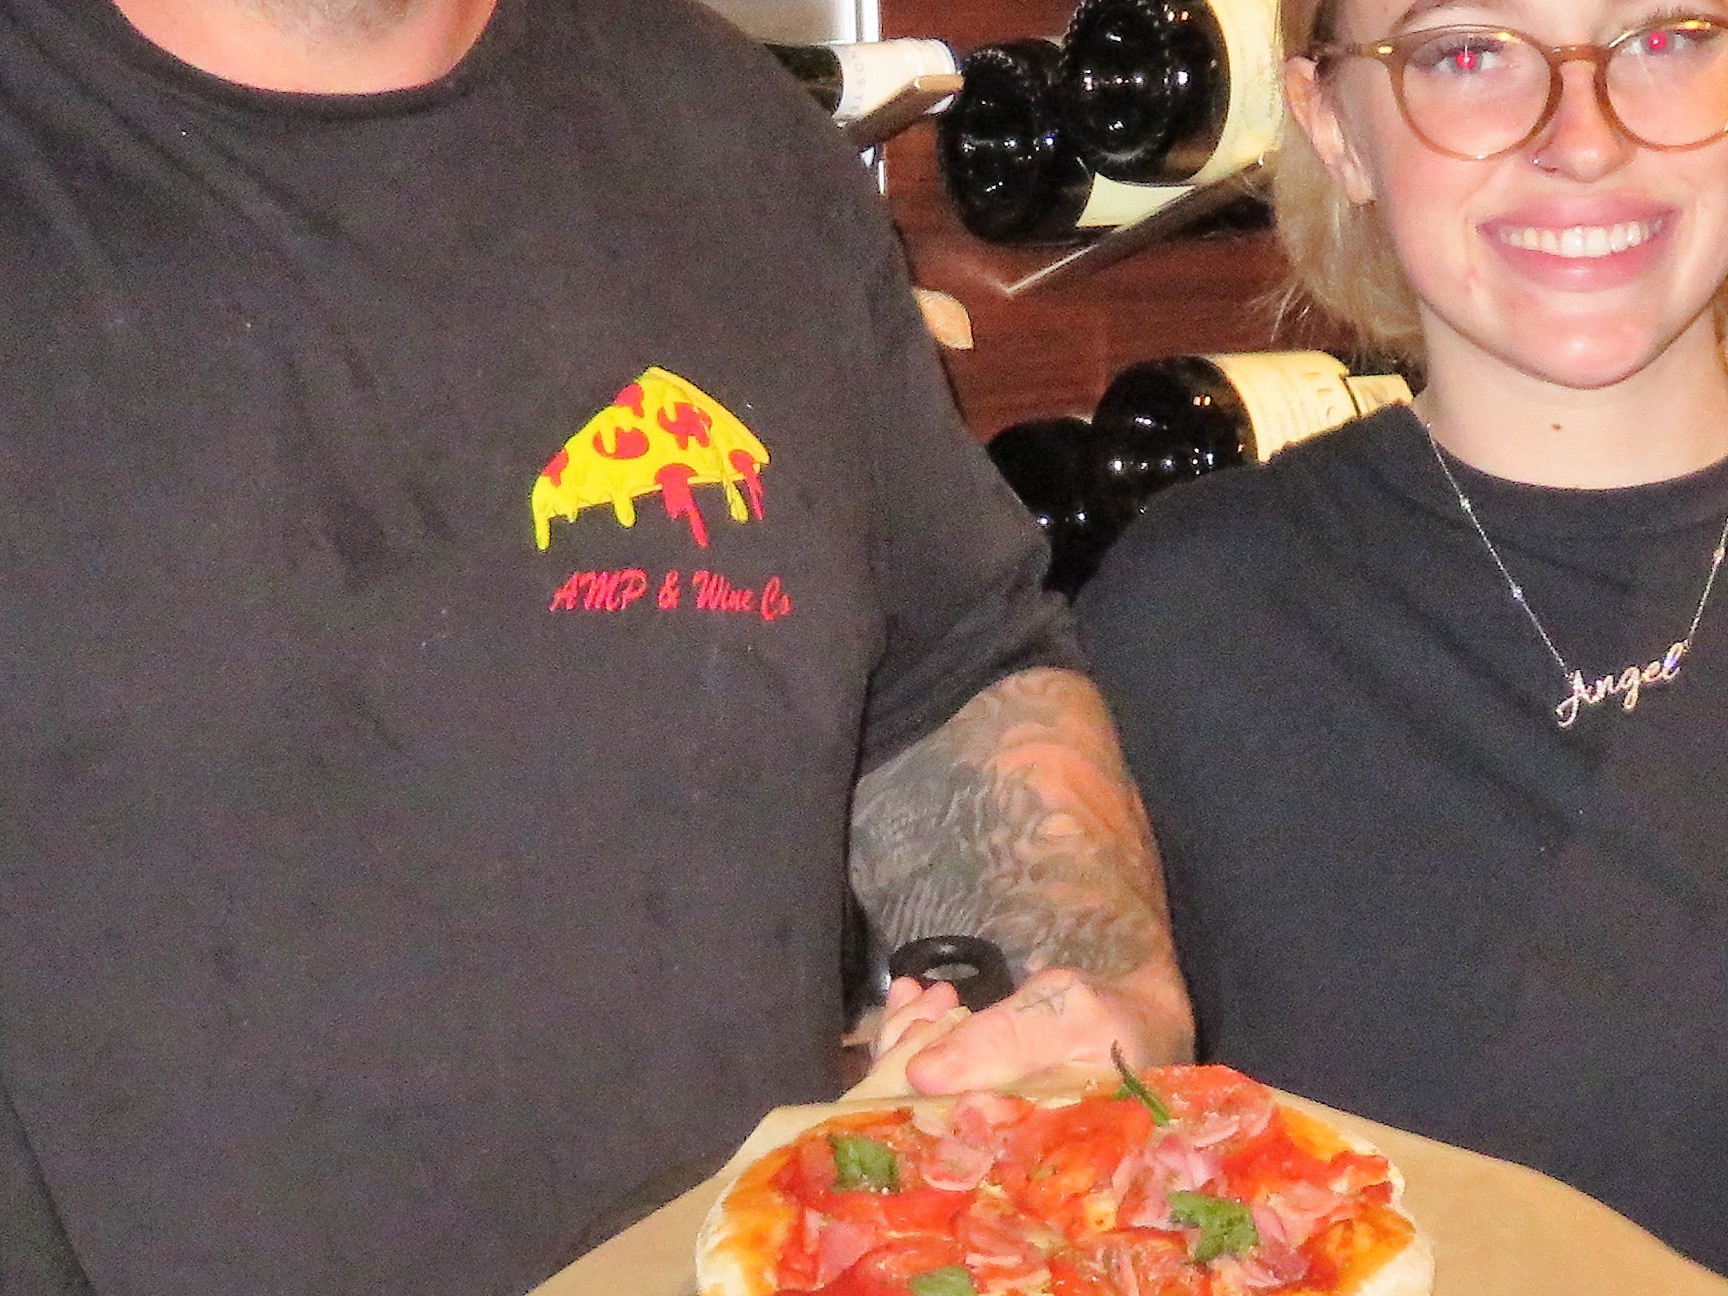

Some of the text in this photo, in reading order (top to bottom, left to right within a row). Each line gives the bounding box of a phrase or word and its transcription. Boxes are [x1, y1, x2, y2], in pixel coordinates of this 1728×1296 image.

[549, 568, 648, 612] AMP
[658, 570, 681, 610] &
[1555, 640, 1690, 728] Angel
